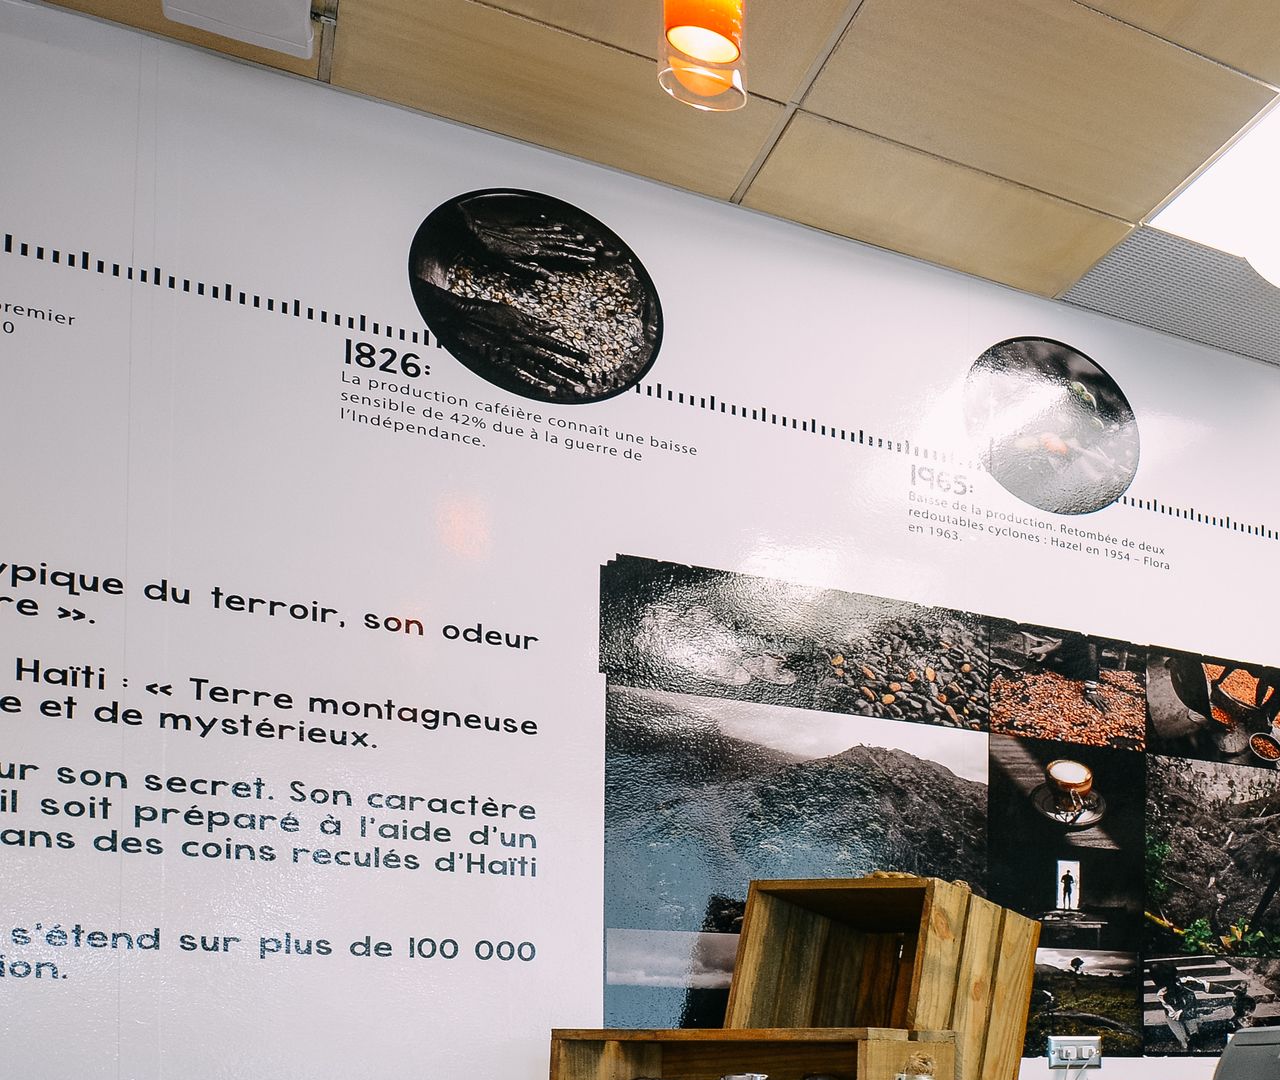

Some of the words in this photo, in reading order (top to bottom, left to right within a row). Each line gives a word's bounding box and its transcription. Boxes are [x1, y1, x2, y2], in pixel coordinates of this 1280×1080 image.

[0, 302, 76, 326] remier
[345, 338, 430, 378] 1826:
[341, 392, 415, 415] sensible
[422, 406, 443, 421] de
[450, 413, 486, 429] 42%
[493, 421, 524, 437] due
[530, 428, 538, 440] à
[545, 431, 558, 444] la
[564, 438, 617, 456] guerre
[623, 448, 642, 461] de
[341, 407, 485, 447] l'Indépendance.
[342, 370, 360, 385] La
[368, 379, 468, 408] production
[475, 402, 542, 423] caféière
[548, 417, 609, 437] connaît
[616, 431, 644, 444] une
[650, 436, 697, 456] baisse
[908, 524, 923, 533] en
[930, 526, 962, 541] 1963.
[144, 579, 190, 605] du
[211, 587, 345, 628] terroir,
[364, 613, 423, 636] son
[443, 623, 539, 650] odeur
[16, 657, 105, 690] Haïti
[189, 677, 293, 709] Terre
[309, 697, 537, 735] montagneuse
[40, 696, 77, 719] et
[94, 701, 142, 725] de
[160, 713, 377, 748] mystérieux.
[57, 767, 127, 789] son
[145, 774, 274, 800] secret.
[290, 781, 352, 806] Son
[367, 793, 536, 820] caractère
[41, 796, 112, 820] soit
[134, 805, 299, 833] préparé
[320, 814, 341, 836] à
[361, 816, 451, 842] l'aide
[469, 825, 536, 849] d'un
[93, 829, 164, 855] des
[181, 837, 276, 861] coins
[293, 847, 420, 870] reculés
[435, 852, 536, 877] d'Haïti
